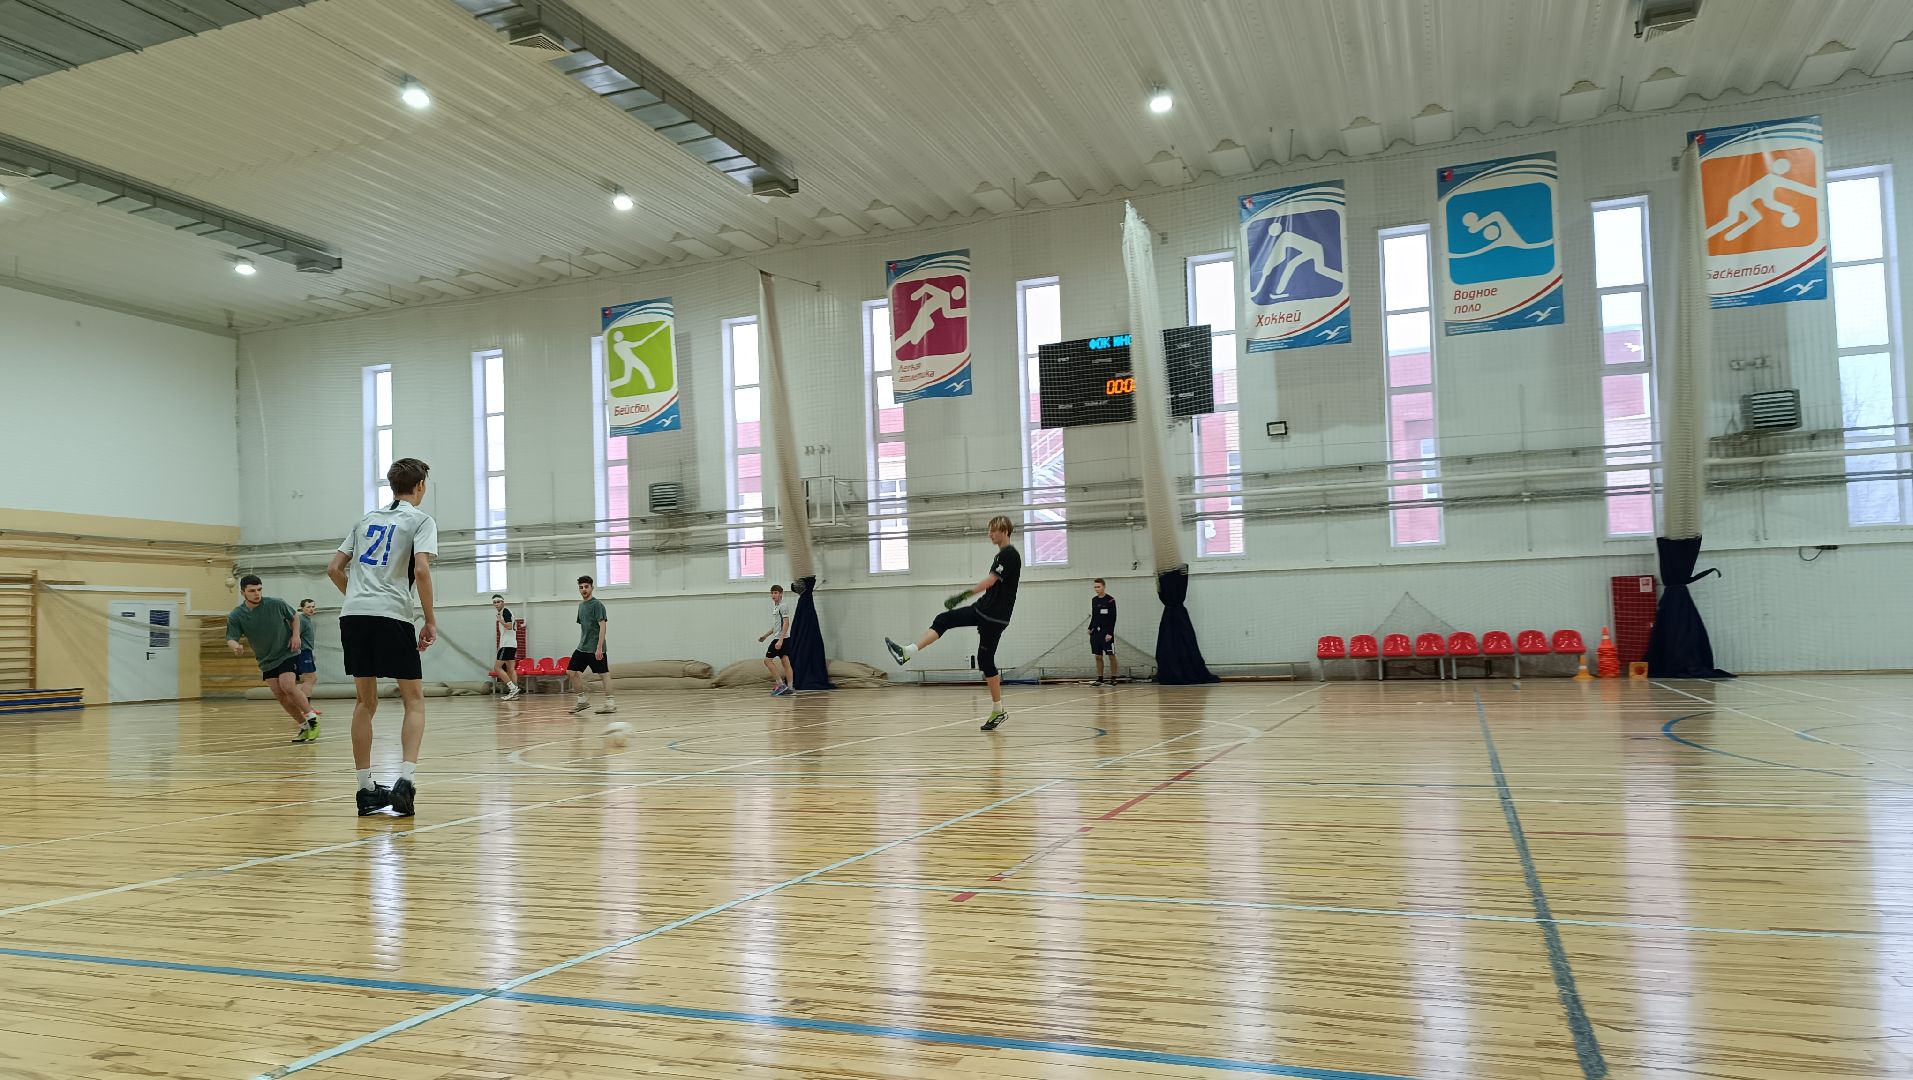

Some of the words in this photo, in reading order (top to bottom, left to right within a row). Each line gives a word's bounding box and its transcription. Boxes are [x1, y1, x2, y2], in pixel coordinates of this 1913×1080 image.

[1453, 287, 1499, 301] Водное
[1453, 303, 1482, 315] поло
[1255, 309, 1302, 328] Хоккей
[613, 403, 650, 417] Бейсбол
[359, 524, 397, 566] 21
